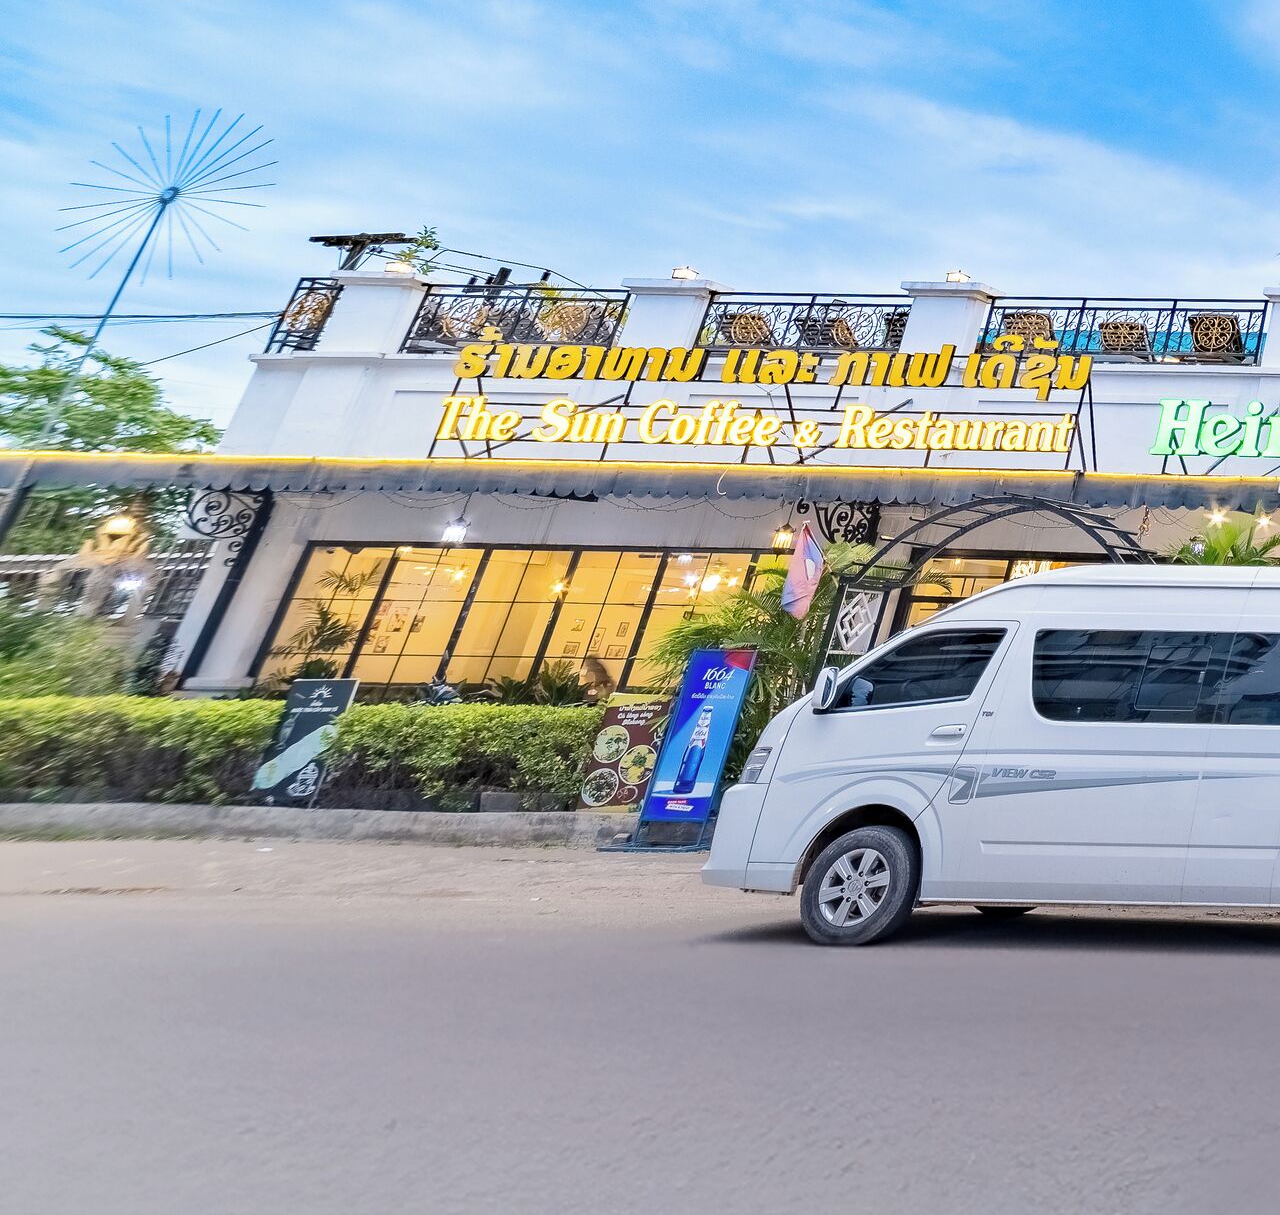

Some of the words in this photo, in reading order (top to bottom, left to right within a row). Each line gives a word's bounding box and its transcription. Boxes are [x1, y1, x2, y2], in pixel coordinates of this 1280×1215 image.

[436, 395, 523, 441] The
[531, 398, 629, 443] Sun
[637, 398, 784, 447] Coffee
[793, 418, 823, 449] &
[835, 404, 1077, 453] Restaurant
[702, 667, 735, 681] 1664
[704, 681, 726, 690] BLANC
[991, 768, 1029, 778] VIEW
